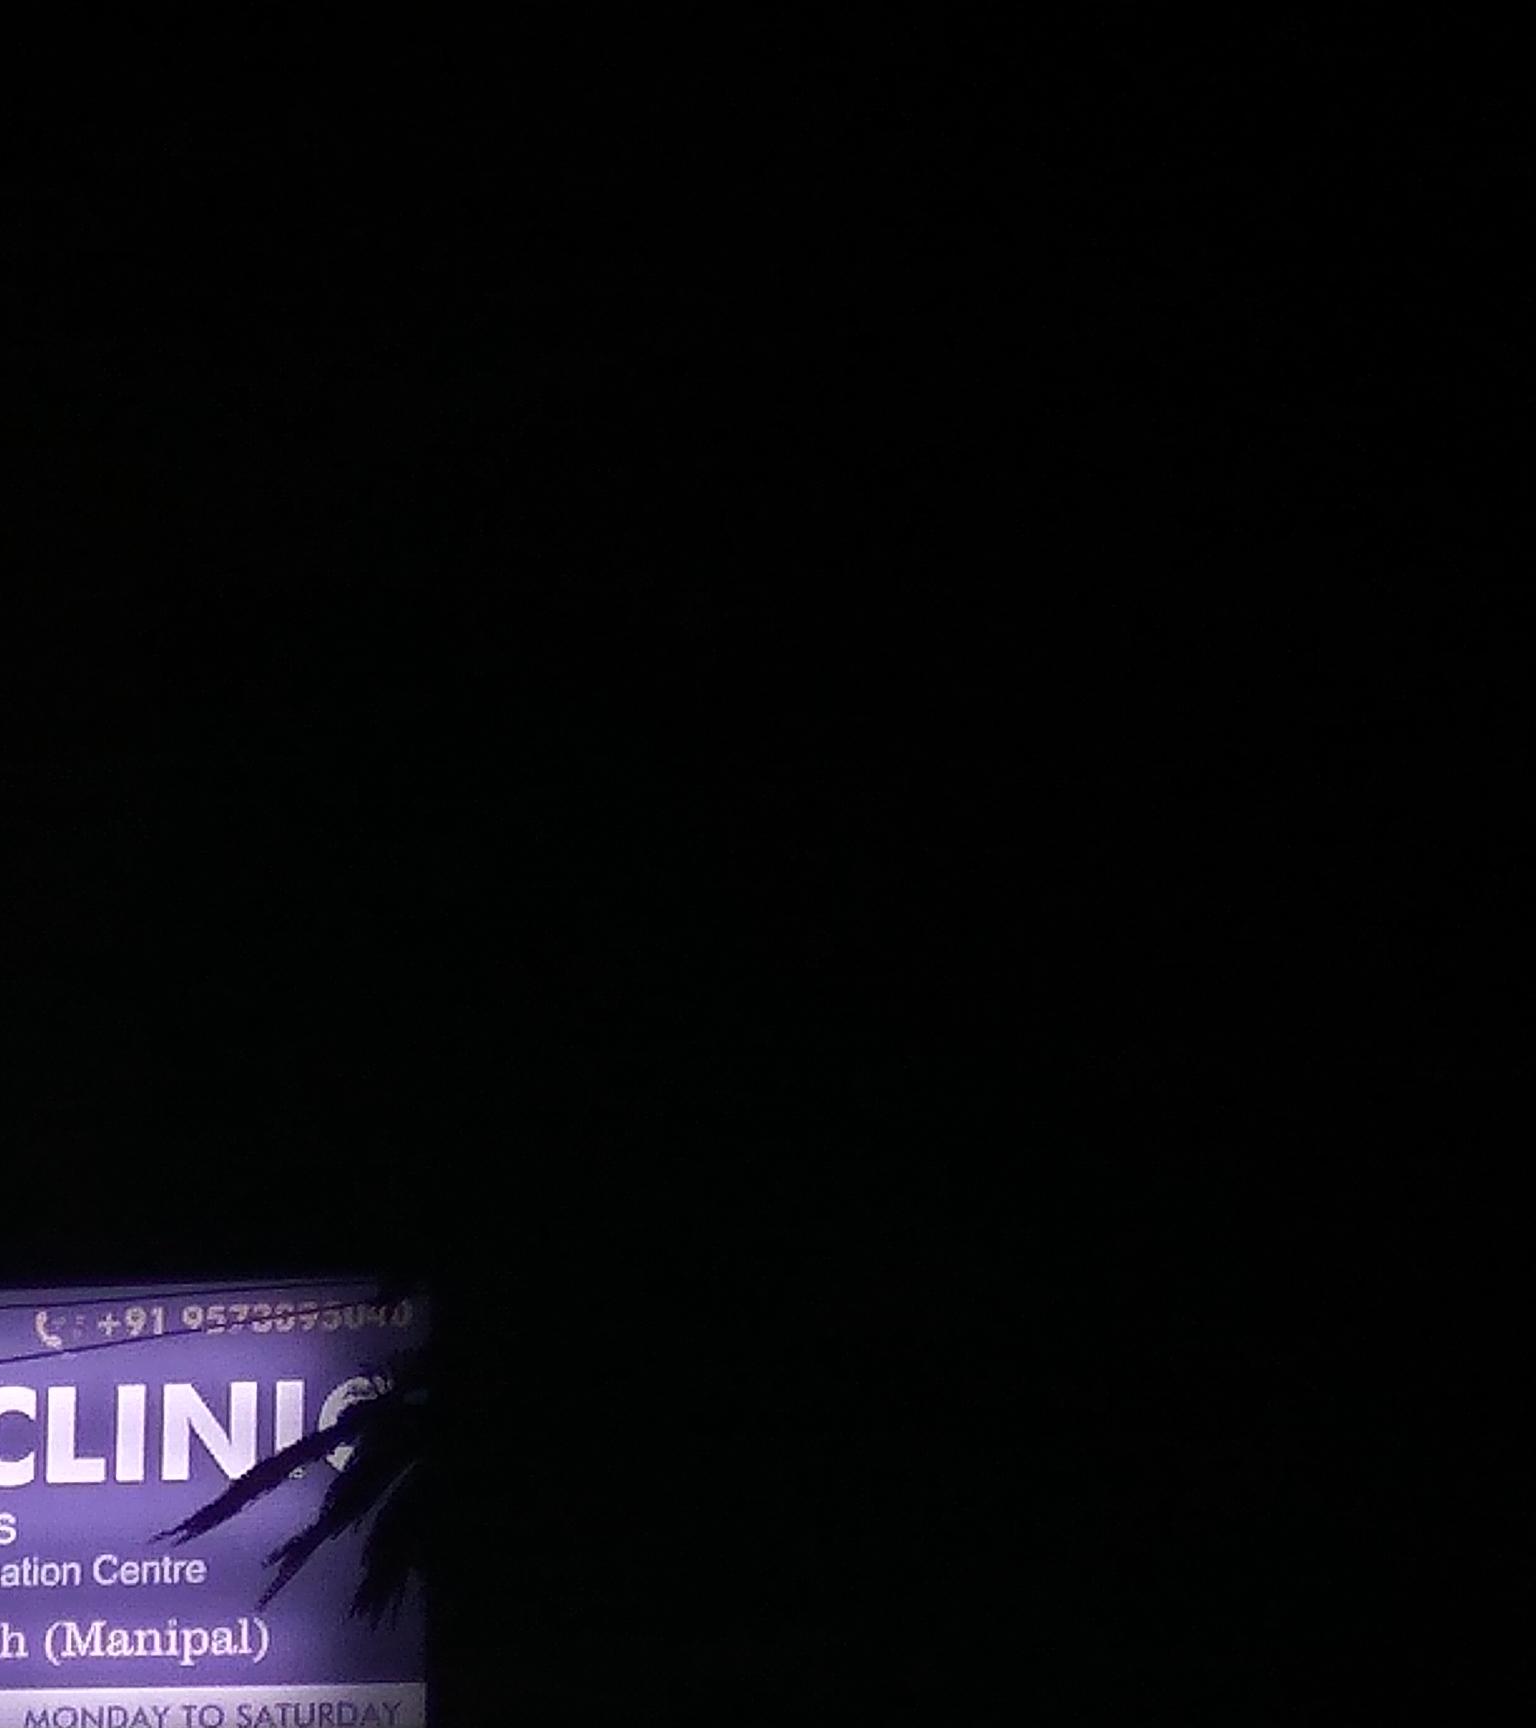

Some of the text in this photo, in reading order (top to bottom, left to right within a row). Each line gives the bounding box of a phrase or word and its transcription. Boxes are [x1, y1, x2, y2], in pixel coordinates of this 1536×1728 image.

[98, 1306, 166, 1337] +91
[93, 1553, 209, 1586] Centre
[44, 1617, 271, 1667] (Manipal)
